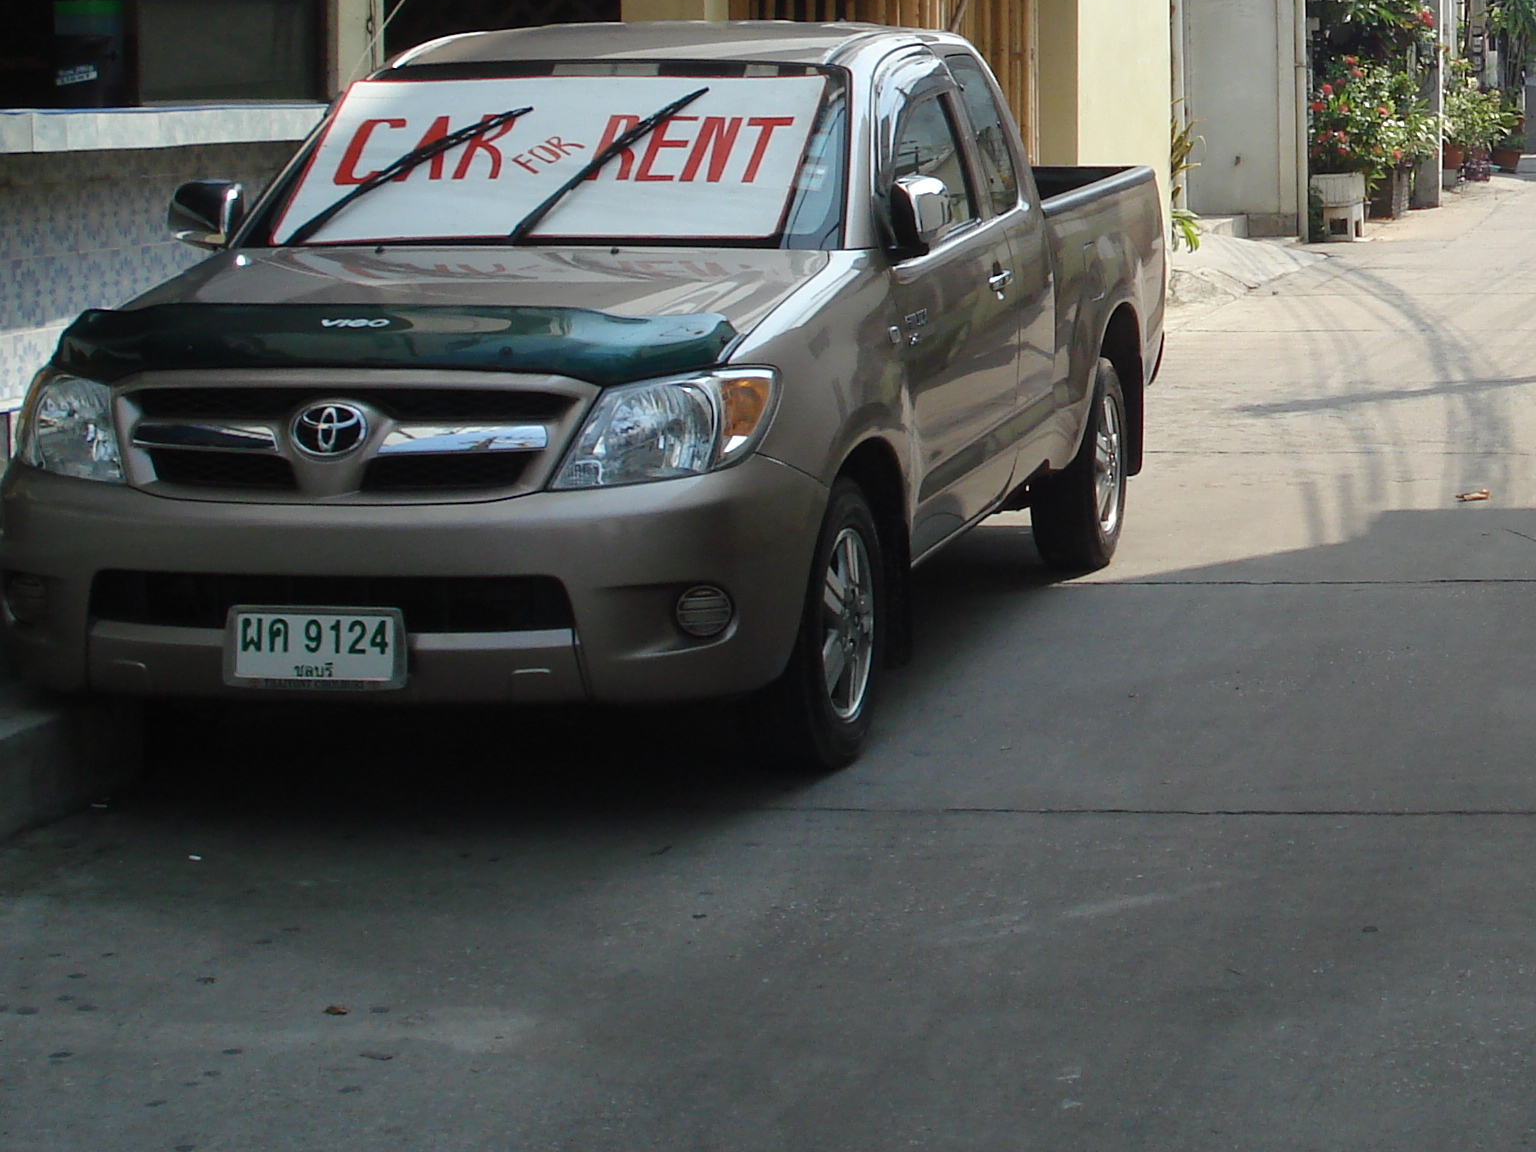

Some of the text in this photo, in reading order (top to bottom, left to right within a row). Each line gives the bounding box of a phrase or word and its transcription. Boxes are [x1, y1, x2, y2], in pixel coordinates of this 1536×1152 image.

[333, 114, 795, 185] CAR FOR RENT
[304, 619, 389, 655] 9124
